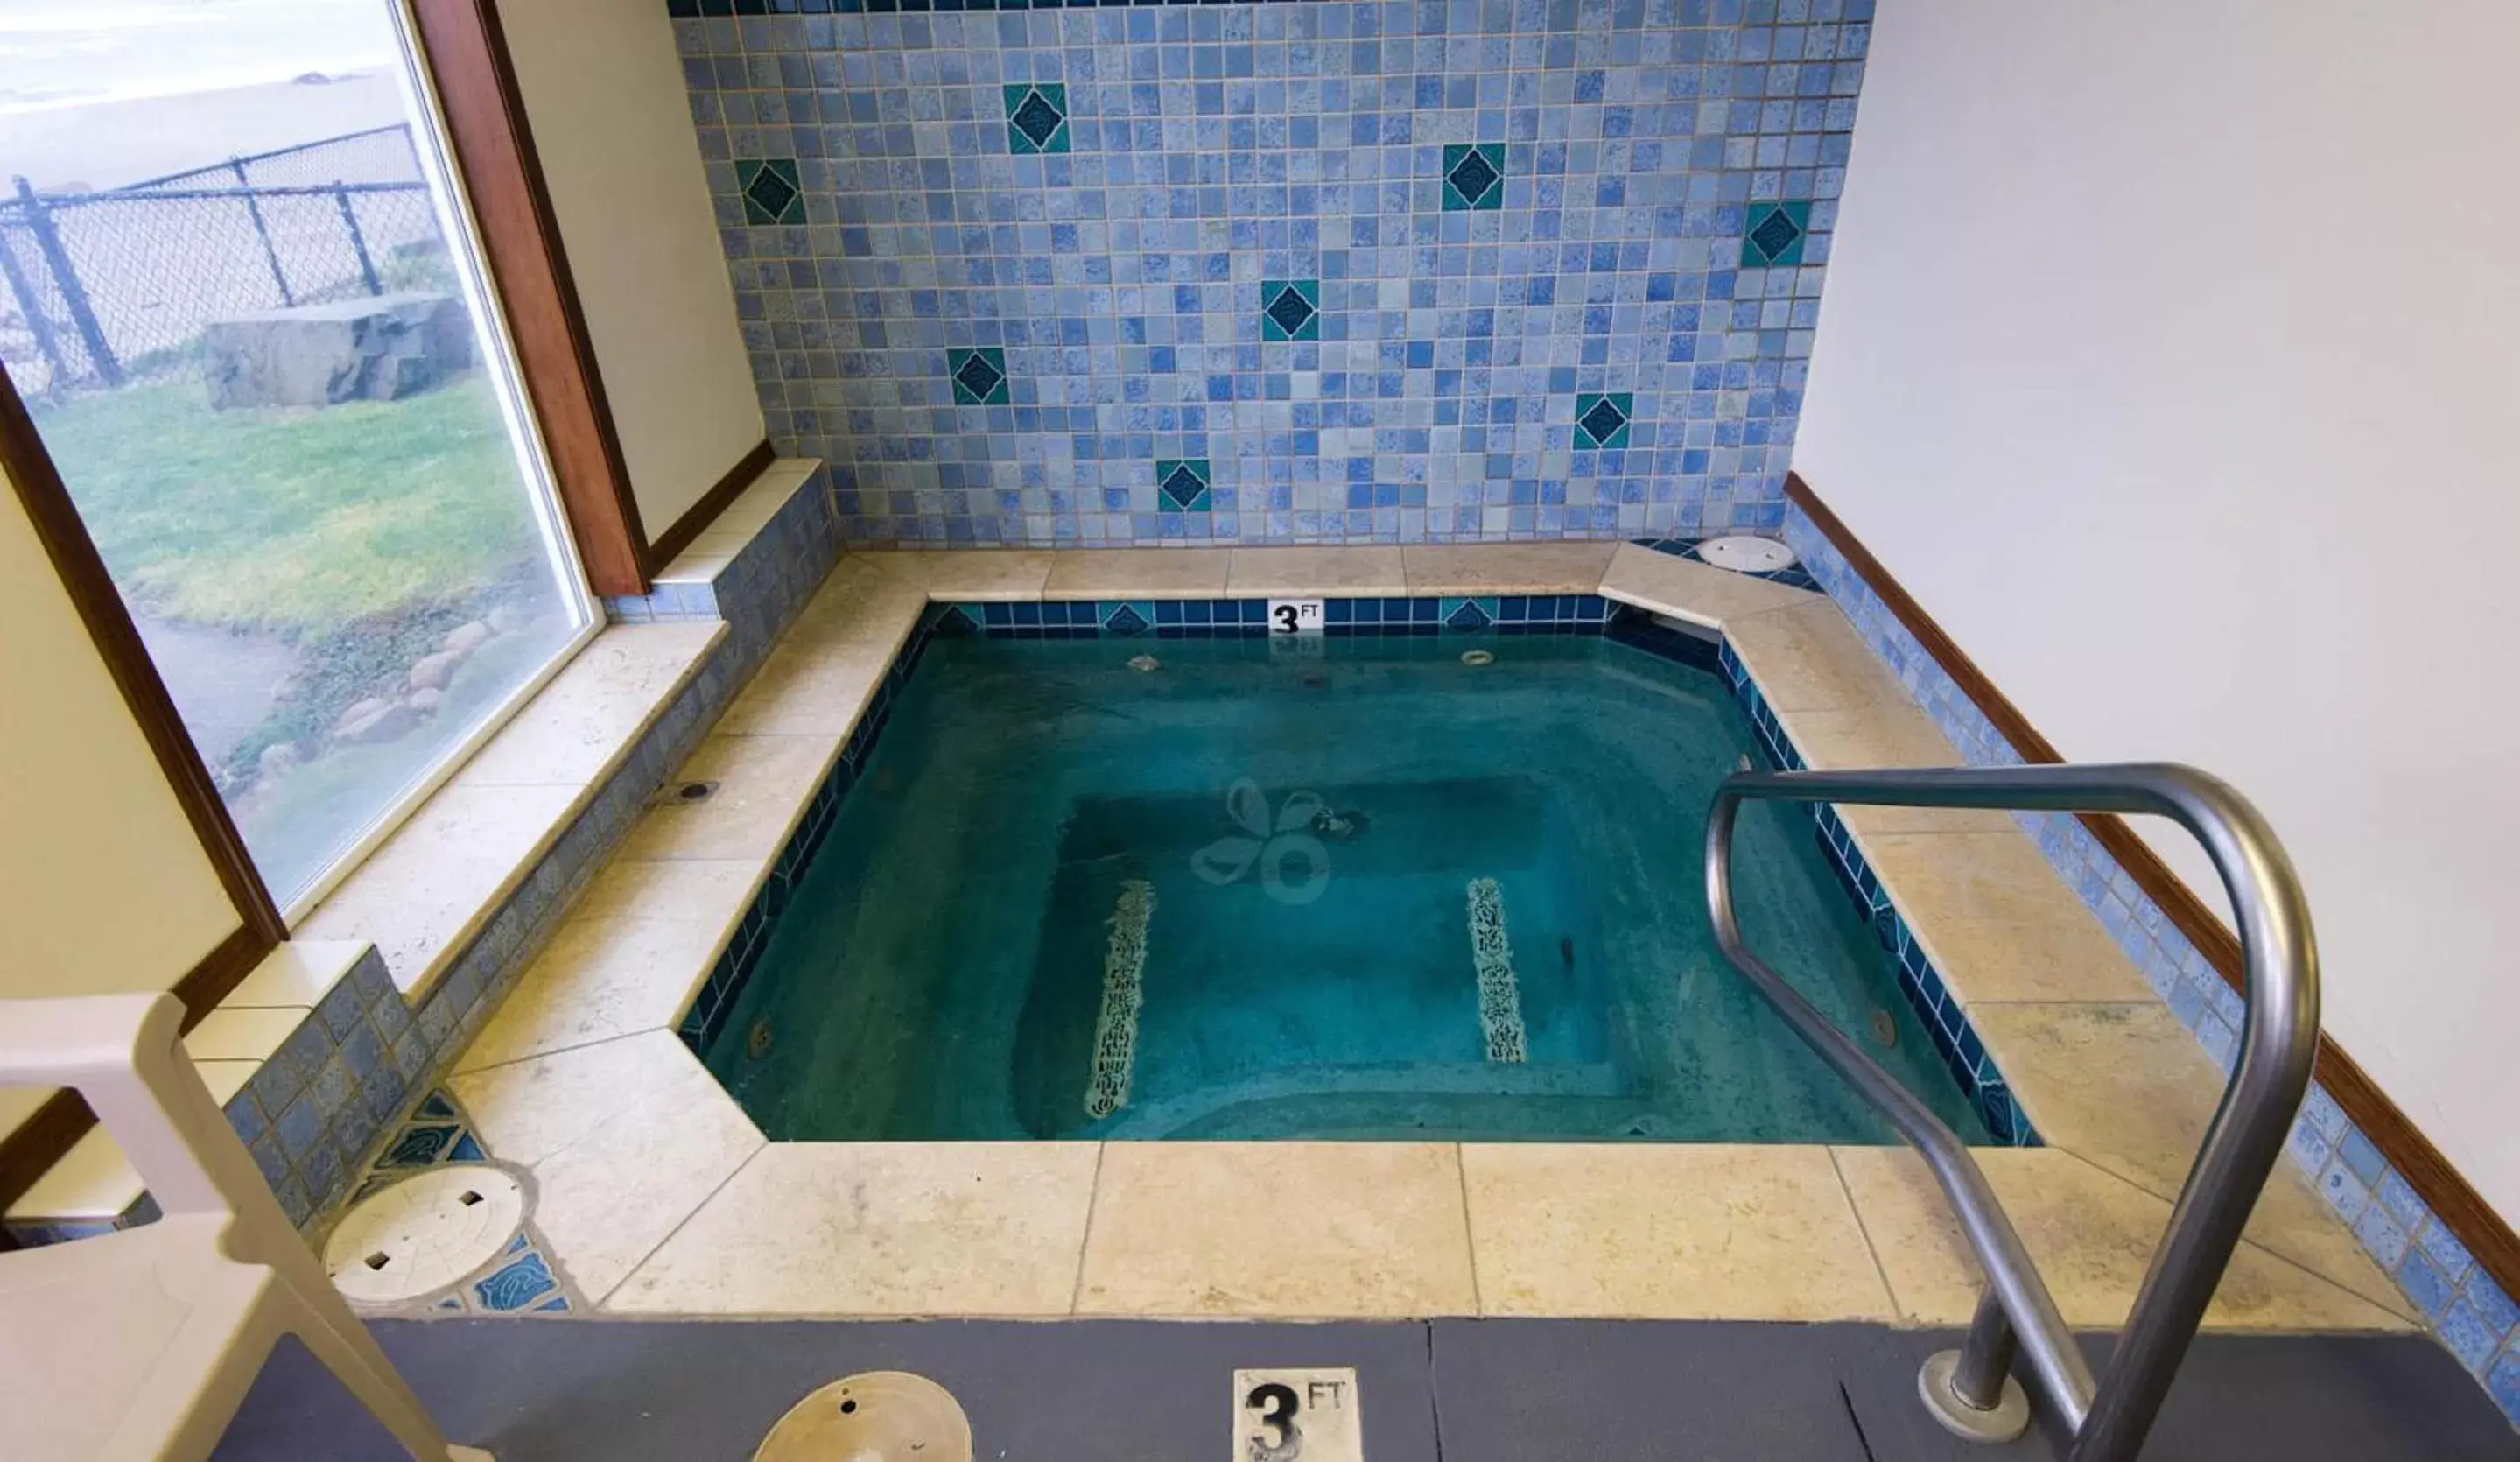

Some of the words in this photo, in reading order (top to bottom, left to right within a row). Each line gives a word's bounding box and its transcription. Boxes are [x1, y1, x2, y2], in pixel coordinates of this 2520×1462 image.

[1274, 604, 1300, 634] 3
[1301, 604, 1319, 617] FT
[1246, 1382, 1302, 1462] 3
[1308, 1381, 1346, 1409] FT
